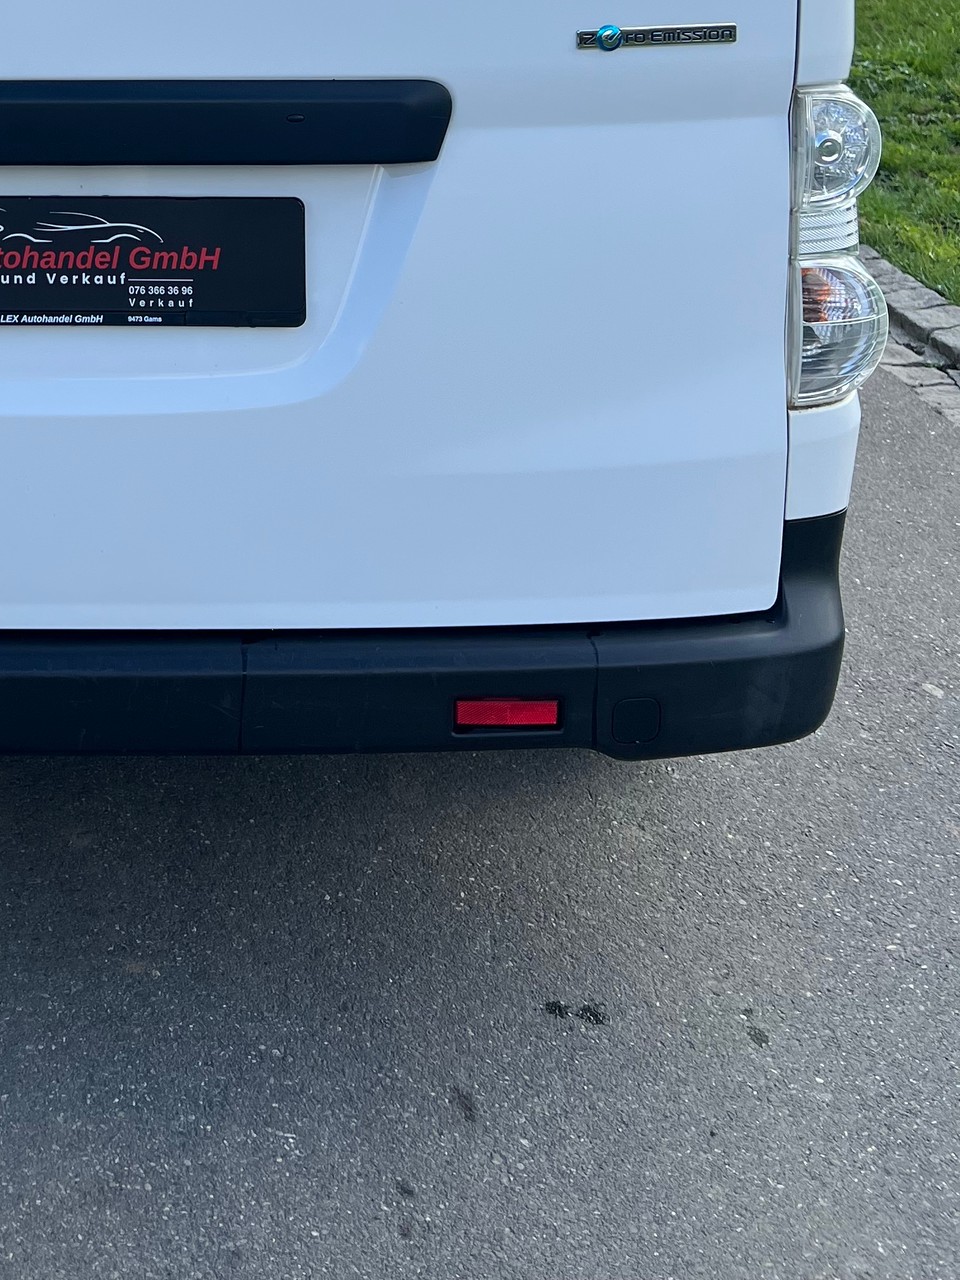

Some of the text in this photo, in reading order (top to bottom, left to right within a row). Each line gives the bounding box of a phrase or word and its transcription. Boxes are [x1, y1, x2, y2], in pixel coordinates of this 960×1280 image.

[129, 246, 221, 270] GmbH
[0, 273, 36, 284] und
[46, 272, 126, 285] Verkauf
[128, 286, 193, 295] 076 366 36 96
[128, 297, 194, 308] Verkauf
[20, 314, 73, 324] Autohandel
[74, 314, 104, 324] GmbH
